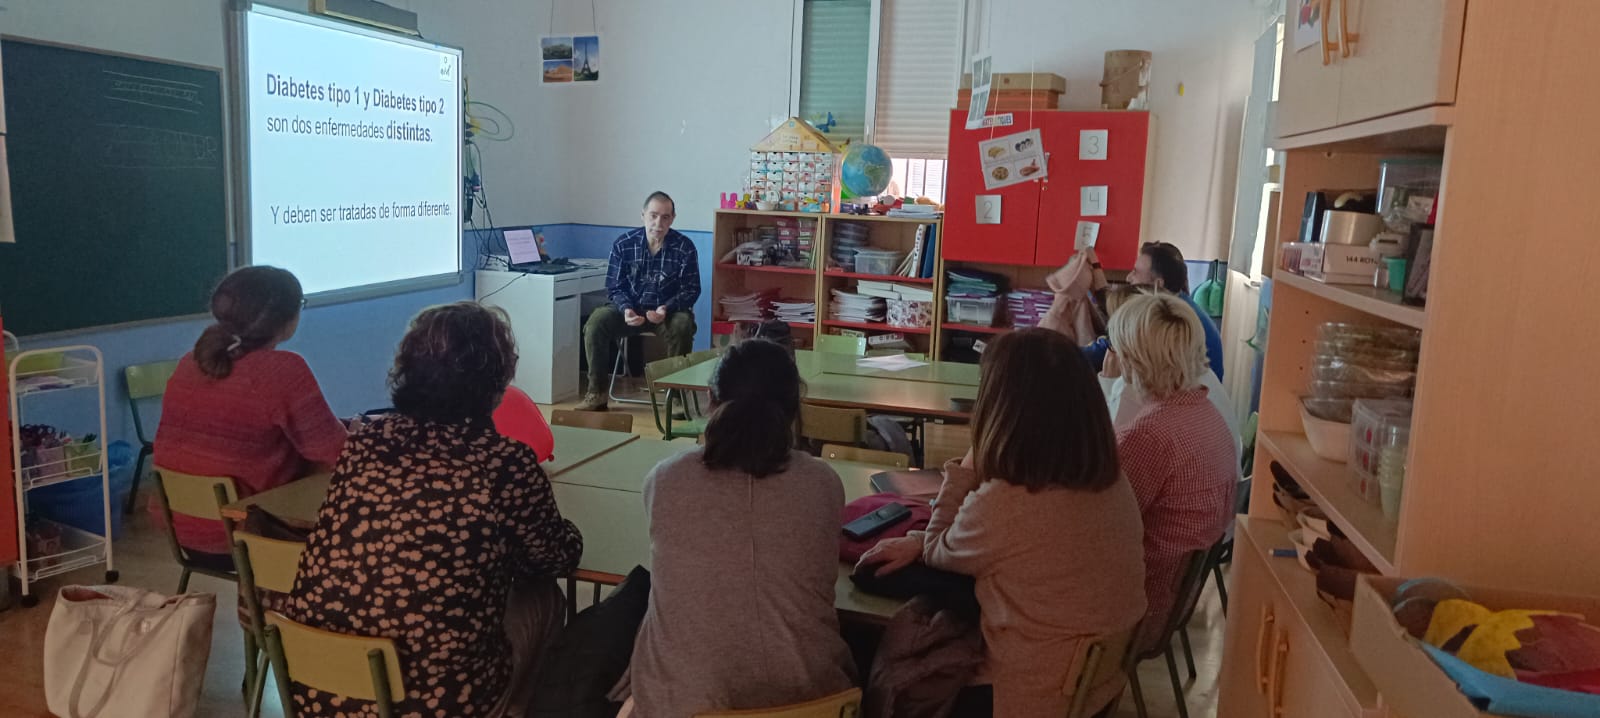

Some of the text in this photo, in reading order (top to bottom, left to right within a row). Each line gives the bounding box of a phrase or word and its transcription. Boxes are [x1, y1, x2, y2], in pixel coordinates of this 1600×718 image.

[266, 73, 445, 117] Diabetes tipo 1 y Diabetes tipo 2
[267, 115, 433, 142] son dos enfermedades distintas.
[1087, 135, 1099, 155] 3
[983, 200, 993, 219] 2
[1089, 191, 1100, 209] 4
[270, 205, 280, 225] Y
[283, 204, 317, 224] deben
[320, 208, 337, 222] ser
[339, 202, 377, 221] tratadas
[379, 202, 390, 219] de
[392, 201, 416, 218] forma
